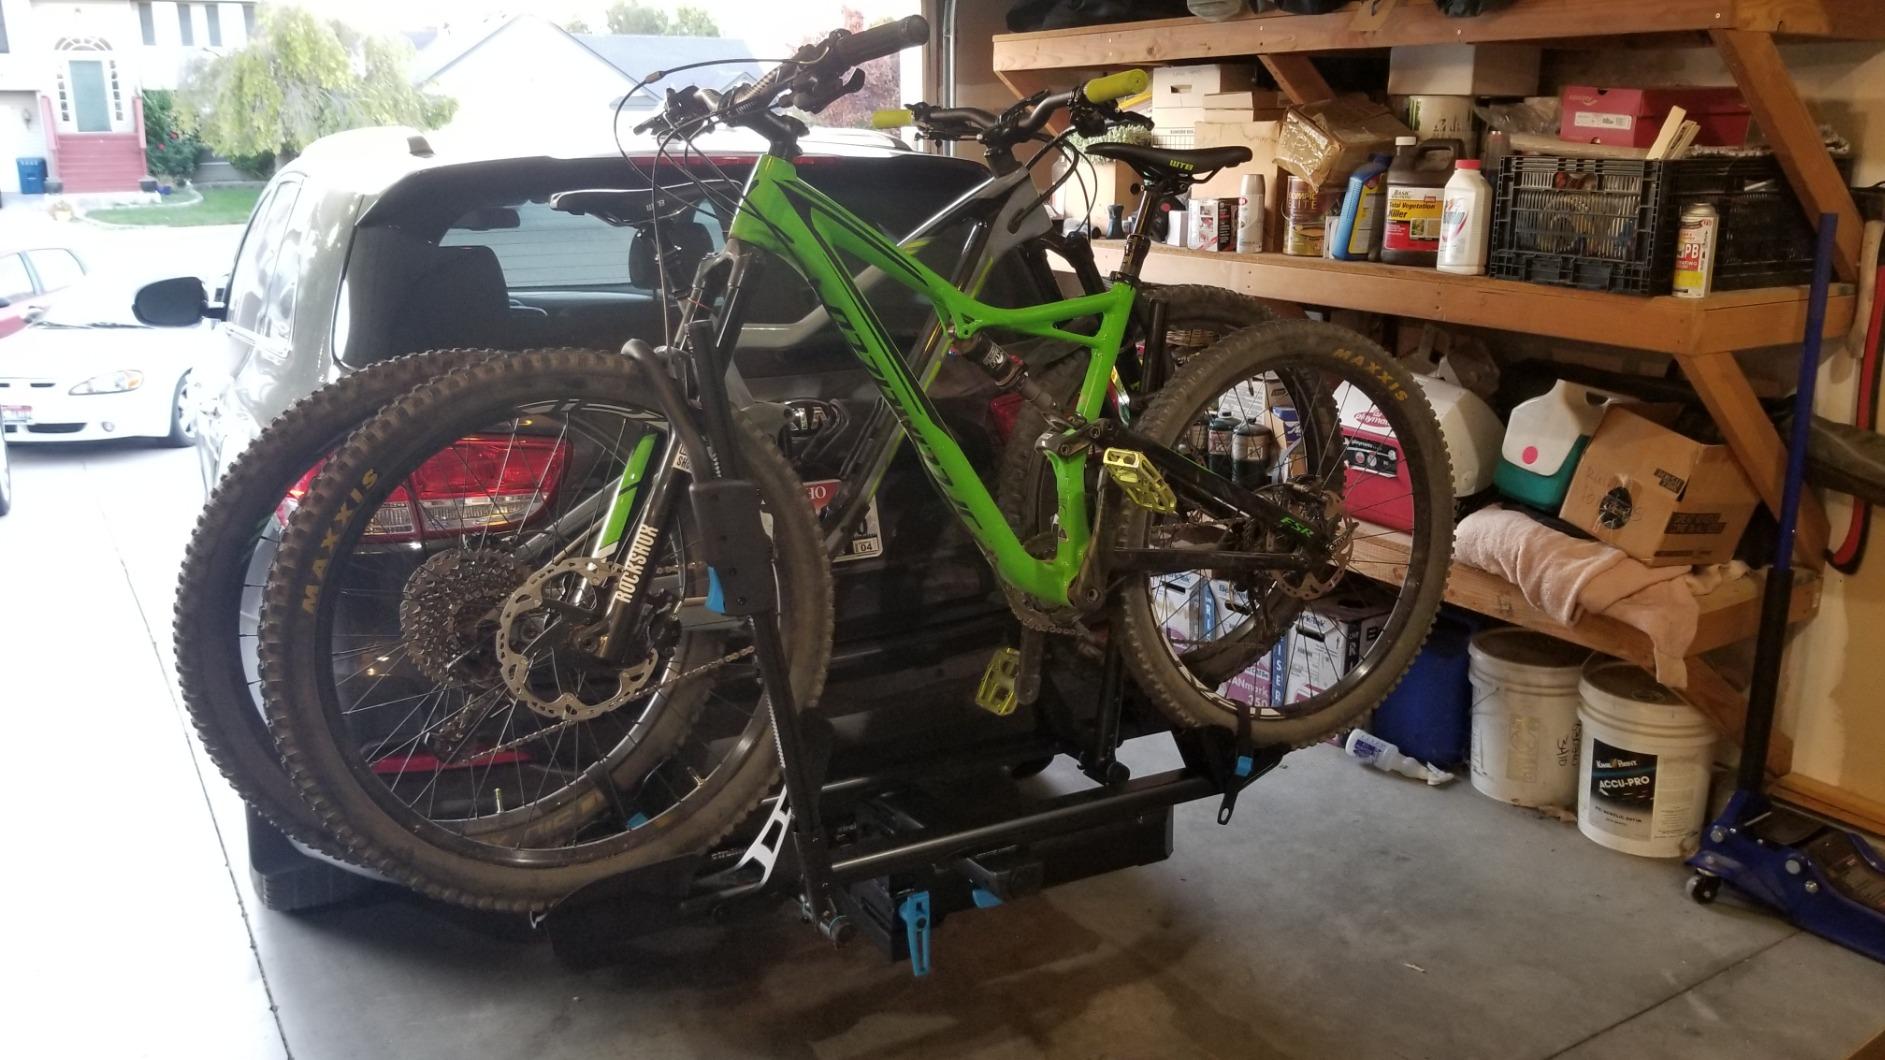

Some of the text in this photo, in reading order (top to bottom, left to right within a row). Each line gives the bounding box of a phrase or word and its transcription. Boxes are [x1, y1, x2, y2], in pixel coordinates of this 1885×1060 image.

[1334, 348, 1408, 401] MAXXIS
[1280, 516, 1315, 538] FSR
[302, 468, 378, 614] MAXXIS
[860, 543, 873, 552] 04
[615, 523, 659, 604] ROCKSHOX
[1229, 676, 1268, 698] ANmark
[1600, 776, 1650, 790] ACCU-PRO
